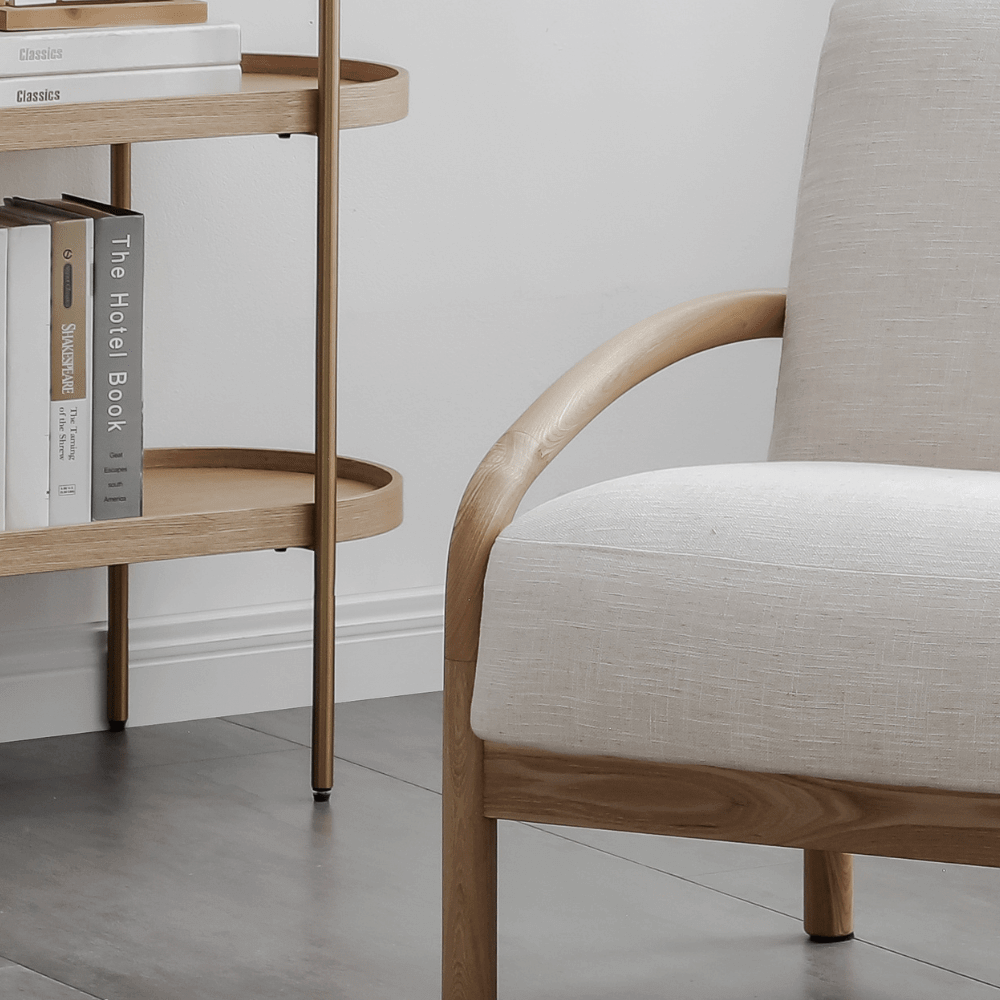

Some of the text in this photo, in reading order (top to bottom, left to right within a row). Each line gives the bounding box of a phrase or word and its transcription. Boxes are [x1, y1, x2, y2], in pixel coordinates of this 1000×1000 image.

[18, 47, 63, 61] Classics
[16, 89, 61, 103] Classics
[61, 323, 76, 395] SHAKESPEARE
[107, 234, 131, 433] The Hotel Book
[58, 406, 67, 461] of the Shrew
[68, 406, 78, 461] The Taming
